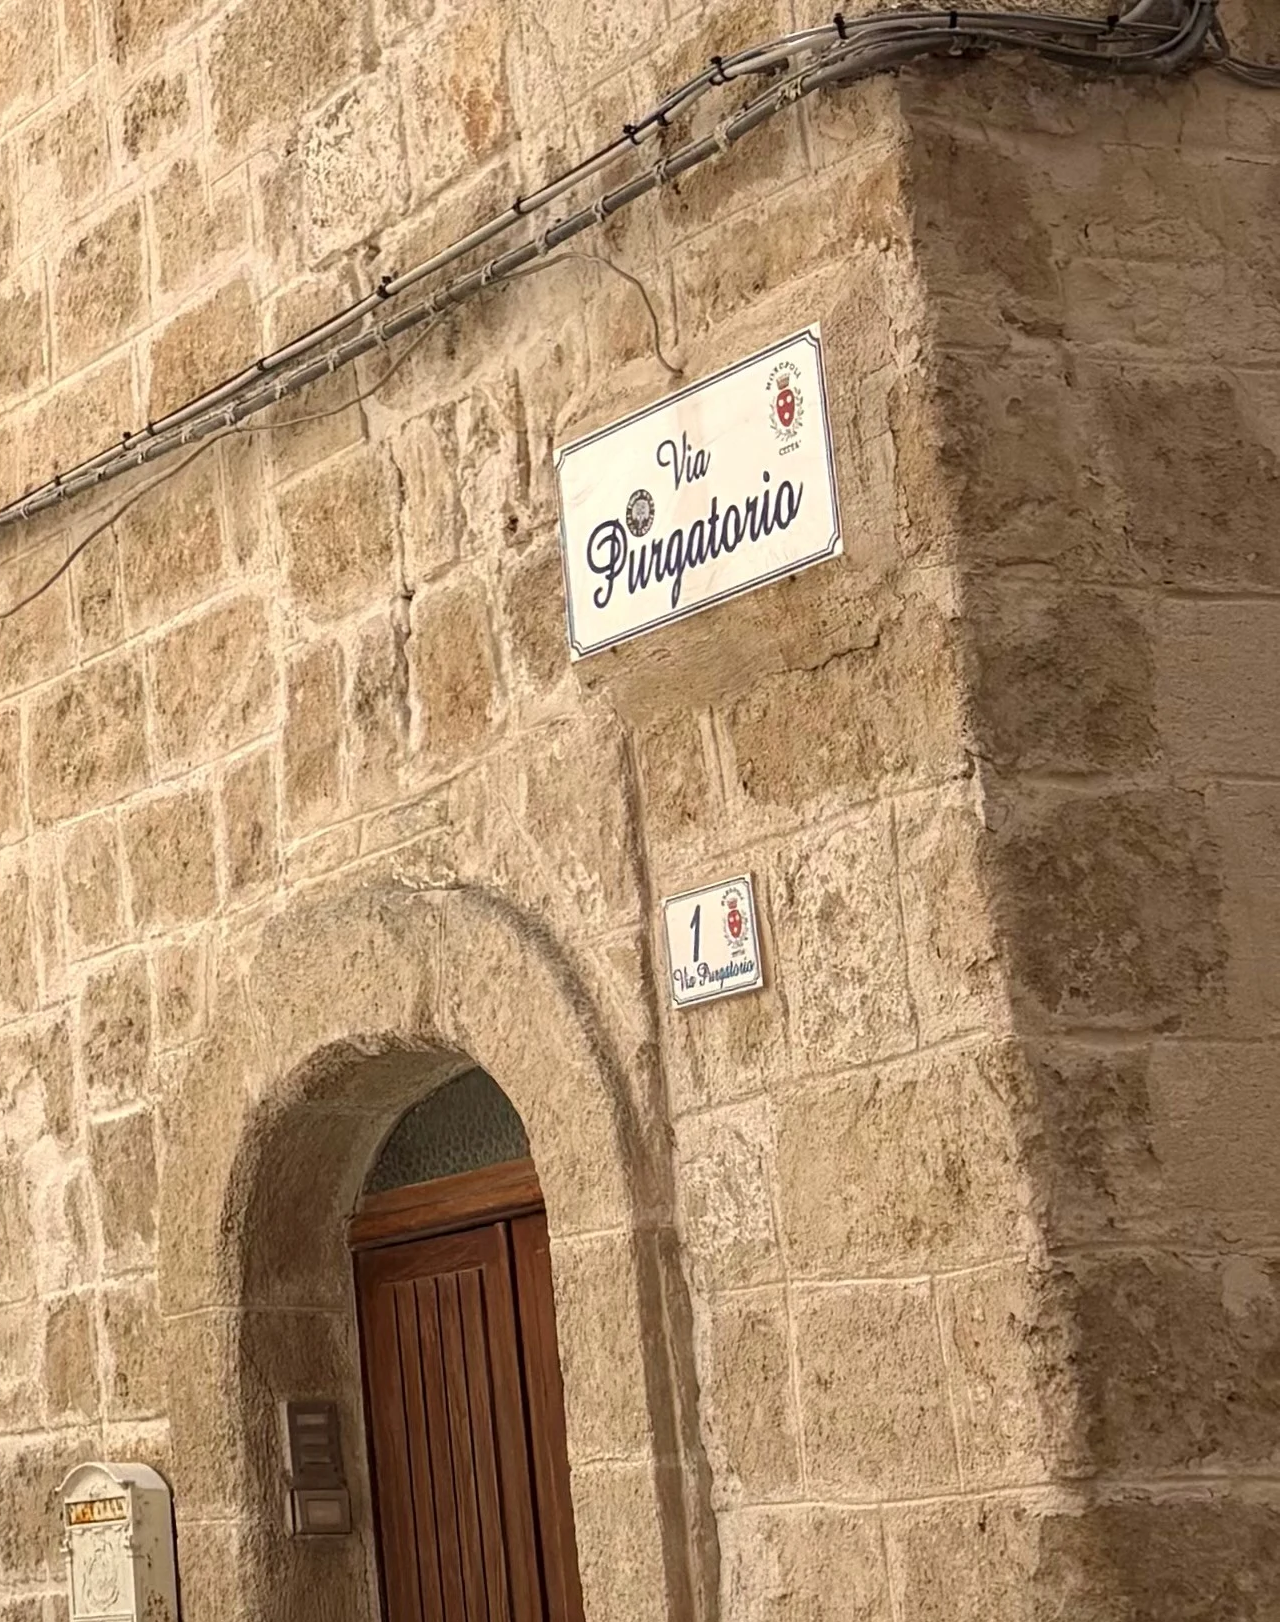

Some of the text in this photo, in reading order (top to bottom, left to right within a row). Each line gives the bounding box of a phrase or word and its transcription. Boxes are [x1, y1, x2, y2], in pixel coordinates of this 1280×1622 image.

[656, 430, 711, 491] Via
[586, 470, 804, 609] Purgatorio
[689, 904, 701, 963] 1
[673, 956, 755, 992] Via Purgatorio
